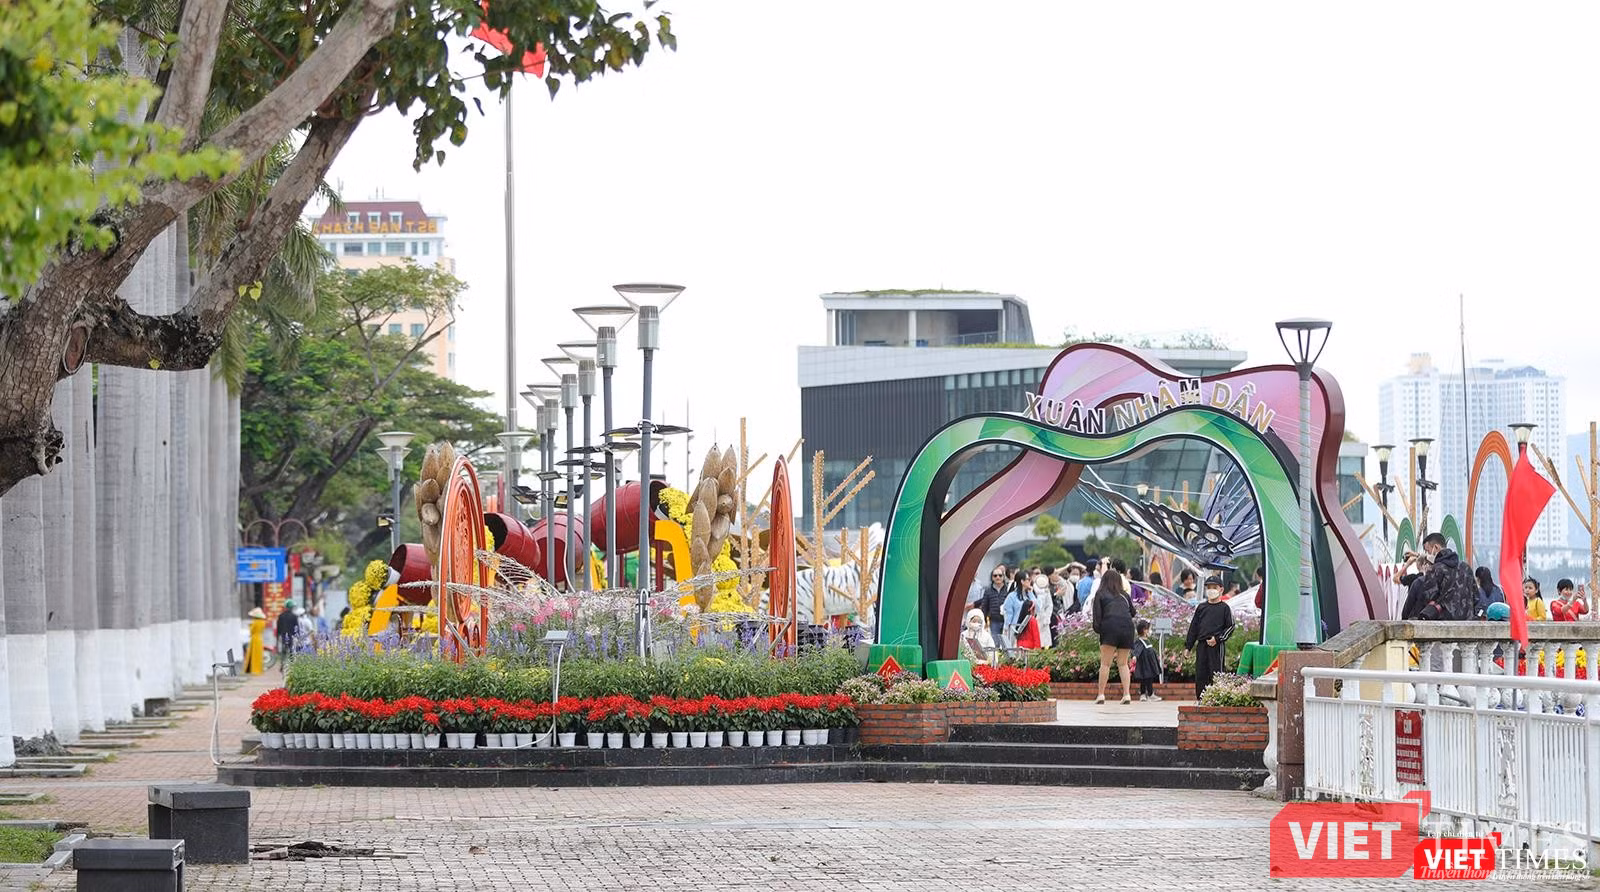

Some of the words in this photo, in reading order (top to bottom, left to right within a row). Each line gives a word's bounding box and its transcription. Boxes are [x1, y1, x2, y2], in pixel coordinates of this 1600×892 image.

[1023, 391, 1105, 433] XUÂN
[1114, 378, 1201, 430] NHÂM
[1211, 381, 1275, 433] DẦN
